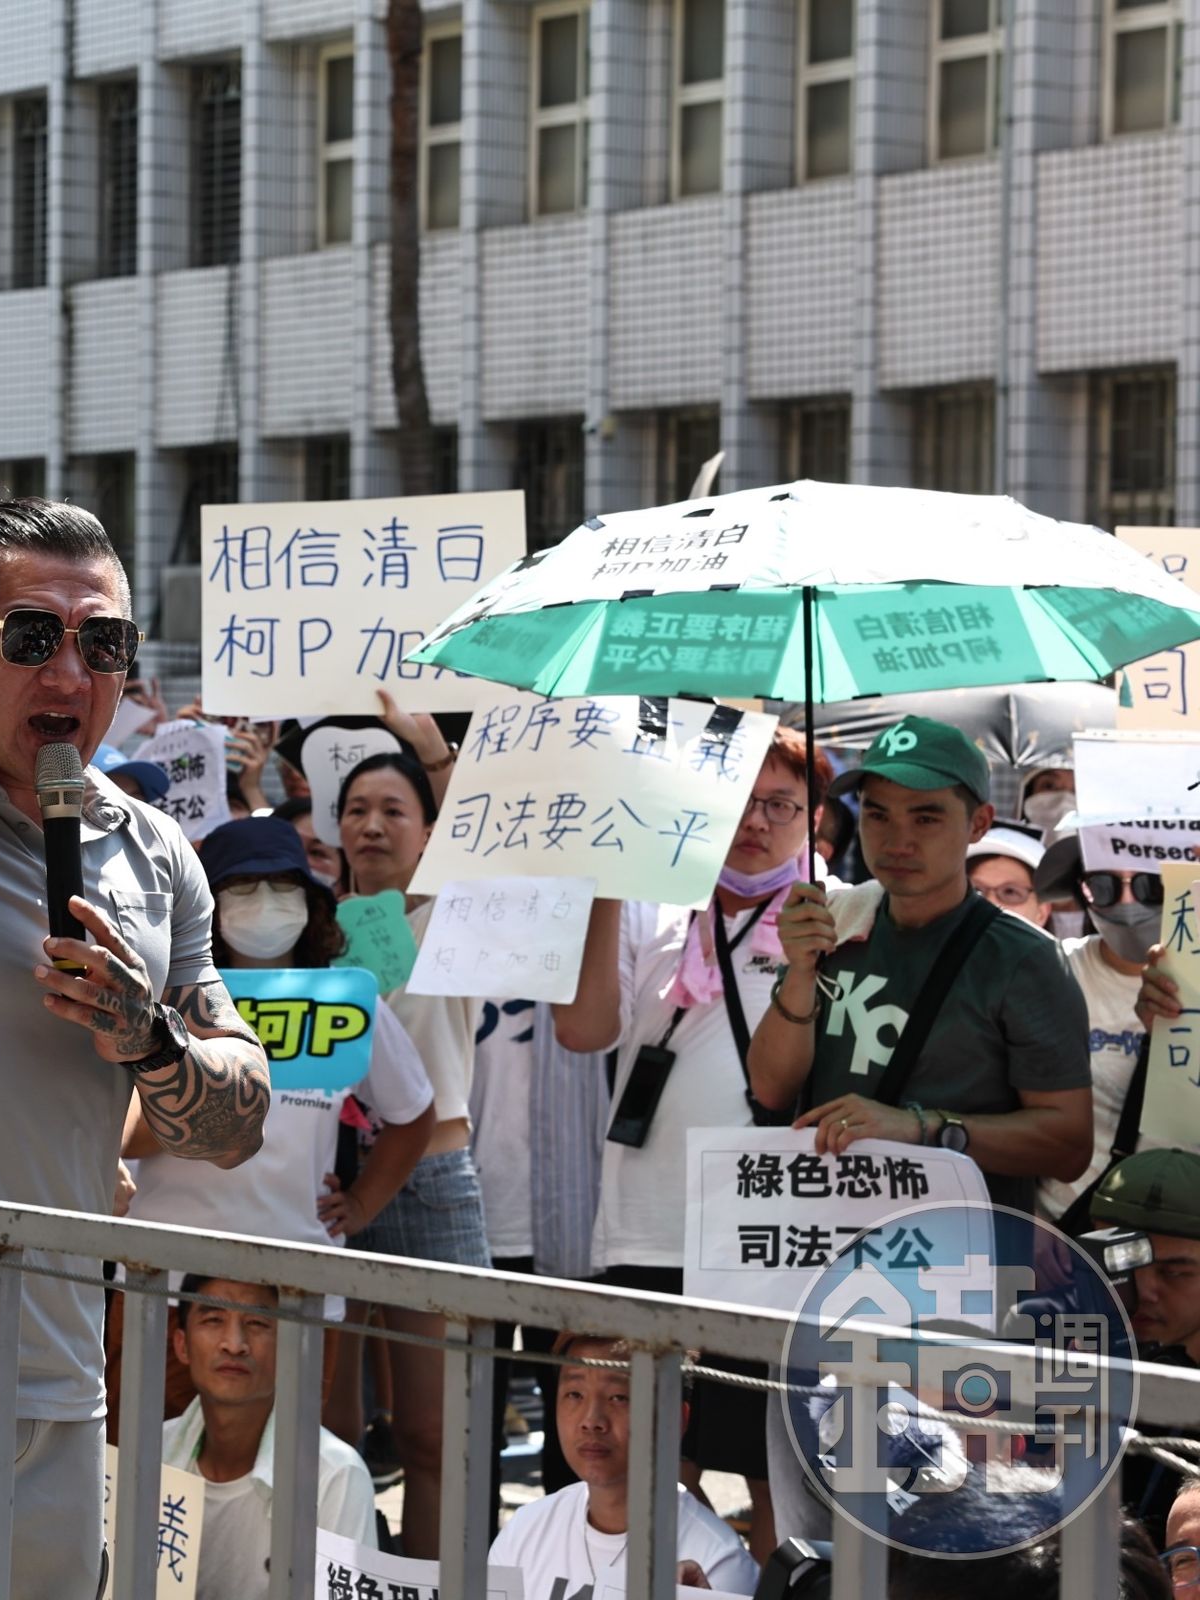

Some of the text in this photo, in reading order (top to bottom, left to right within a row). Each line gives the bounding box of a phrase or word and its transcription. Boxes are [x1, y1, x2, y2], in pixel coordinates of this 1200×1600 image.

[209, 517, 484, 592] 相信清白
[601, 524, 748, 557] 相信清白
[214, 614, 472, 680] 柯P加
[157, 753, 206, 783] 恐怖
[451, 792, 711, 868] 司法要公平
[236, 997, 371, 1061] 柯P
[280, 1094, 332, 1110] Promise
[737, 1153, 929, 1199] 綠色恐怖
[737, 1225, 934, 1272] 司法不公
